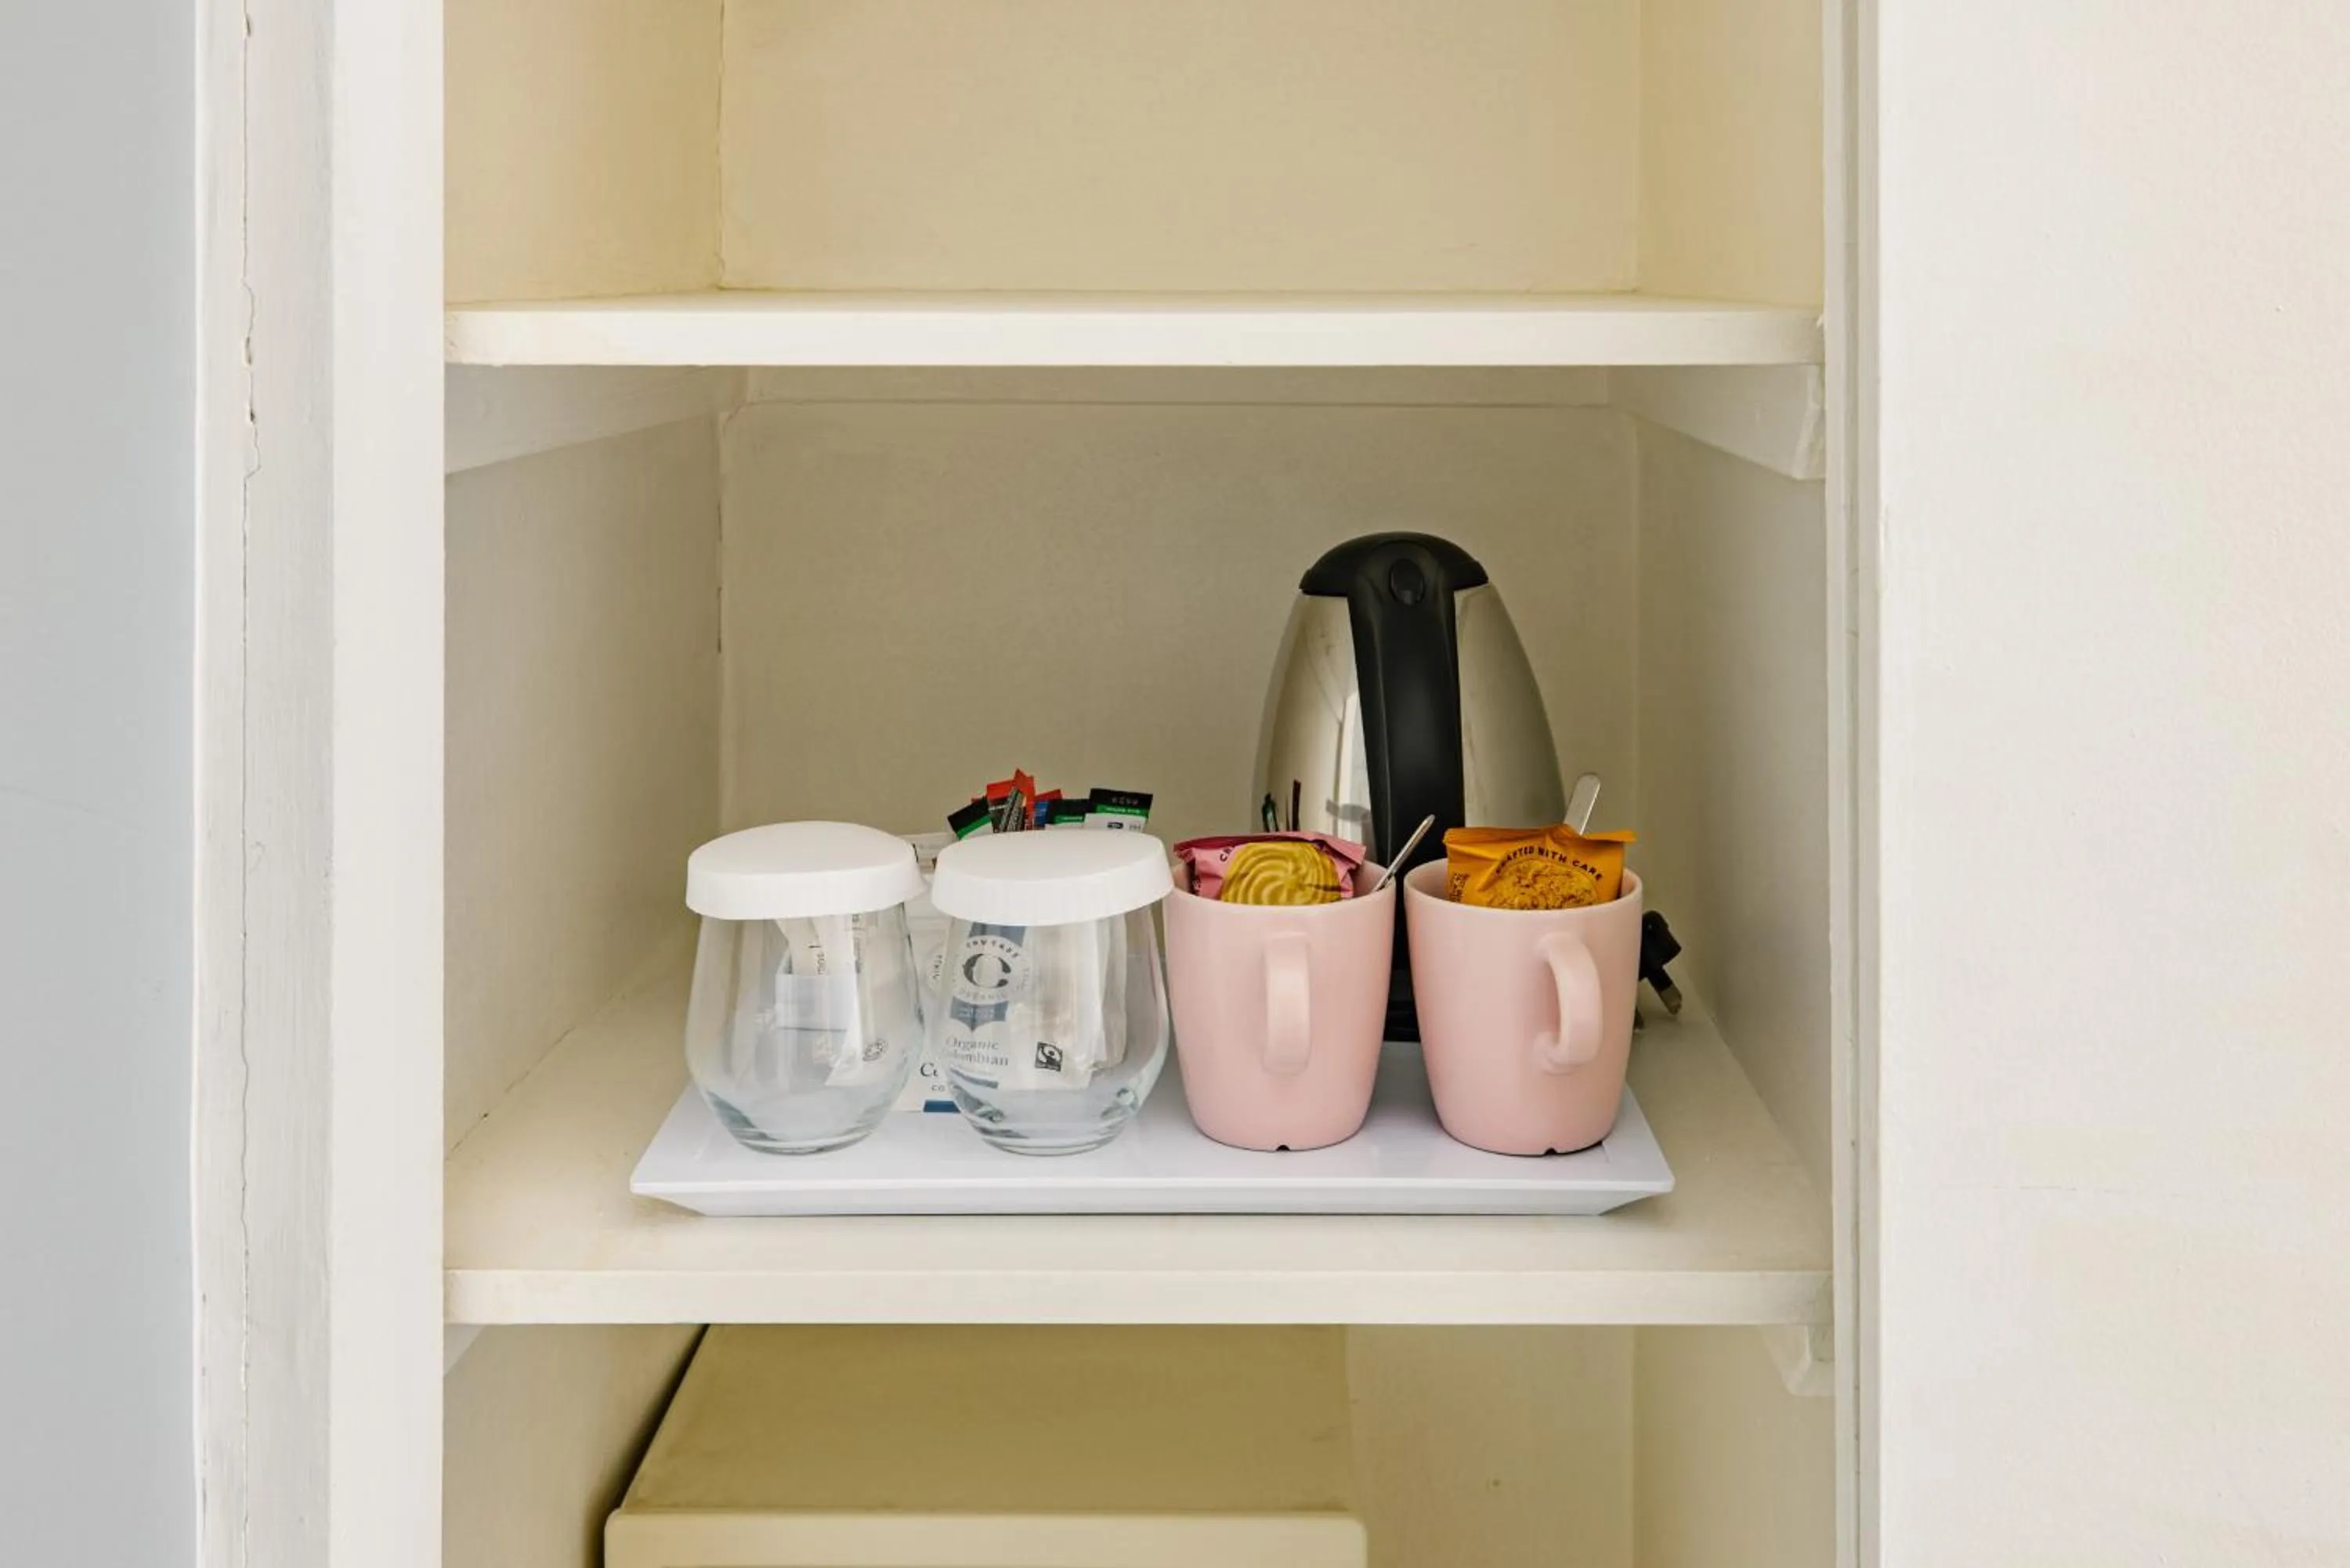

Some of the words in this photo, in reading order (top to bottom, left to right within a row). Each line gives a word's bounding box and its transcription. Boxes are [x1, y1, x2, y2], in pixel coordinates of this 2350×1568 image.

[1496, 845, 1535, 874] CRAFTED
[1538, 846, 1567, 863] WITH
[1572, 858, 1603, 880] CARE
[945, 1036, 1000, 1051] Organic
